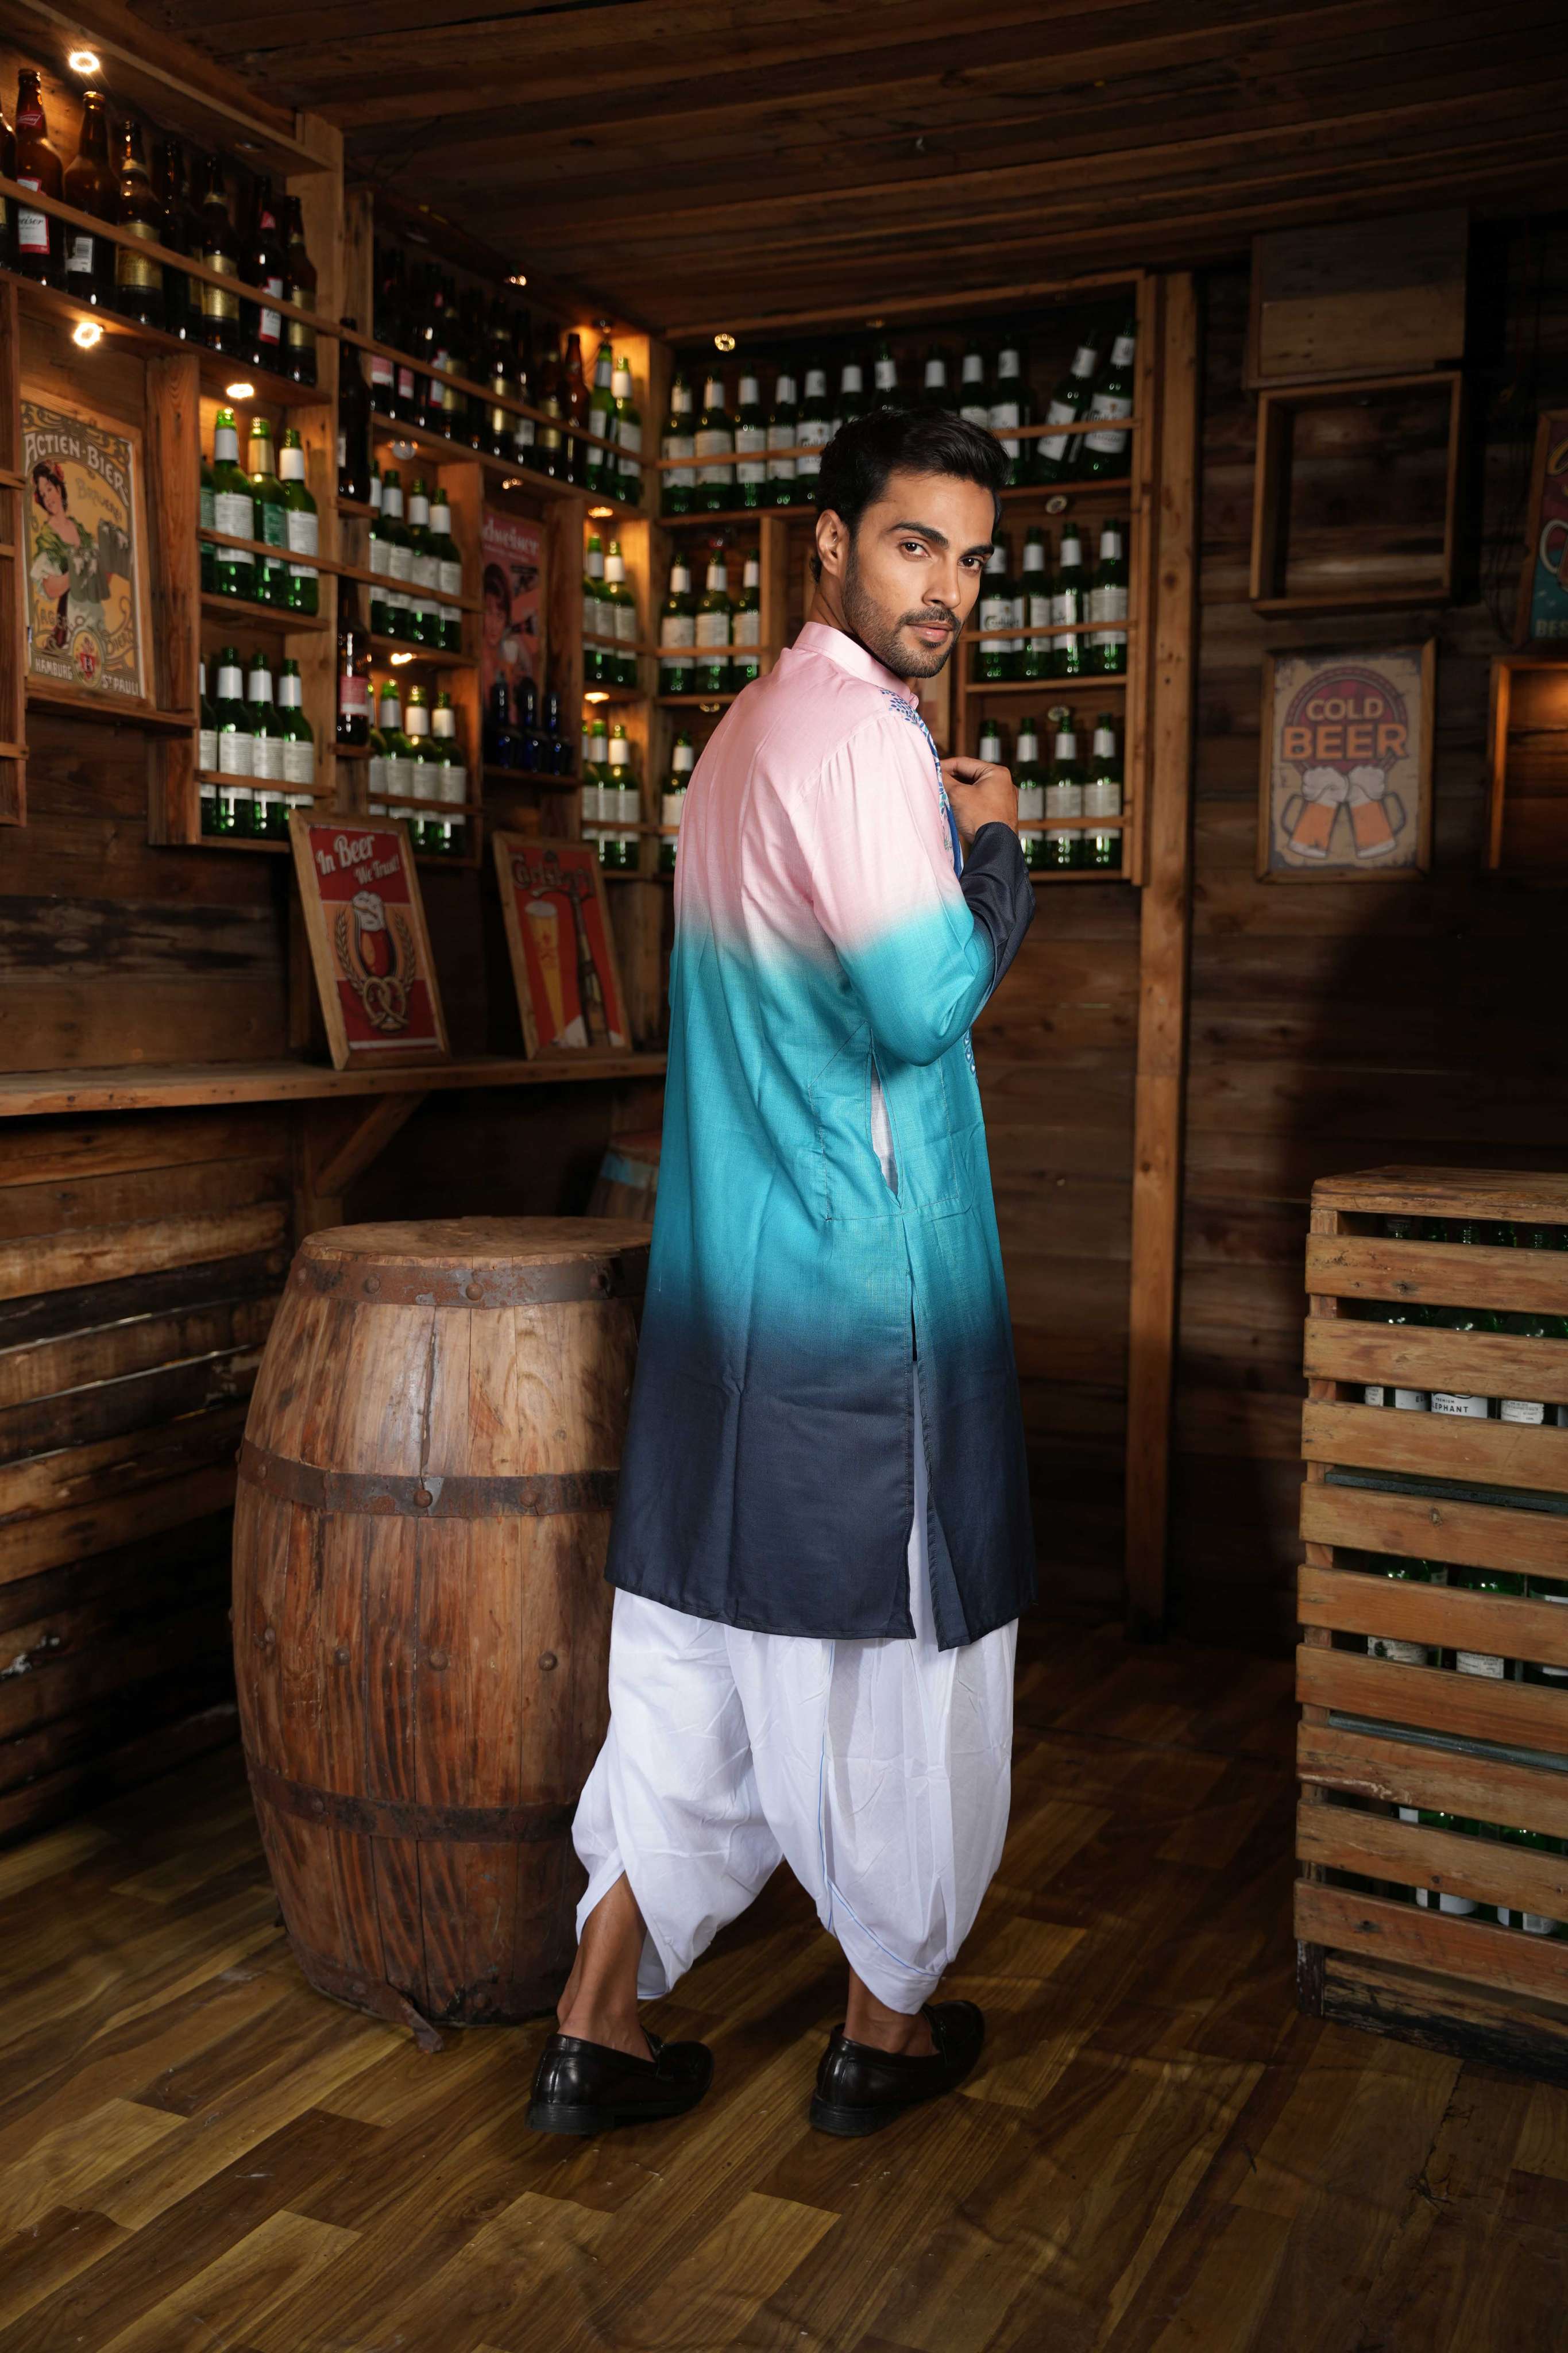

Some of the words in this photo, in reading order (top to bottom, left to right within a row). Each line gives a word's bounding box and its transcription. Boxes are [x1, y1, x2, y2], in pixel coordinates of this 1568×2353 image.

[35, 657, 74, 680] HAMBURG
[114, 676, 140, 697] PAULI
[1305, 696, 1384, 722] COLD
[1281, 723, 1408, 762] BEER
[315, 848, 336, 875] In
[333, 834, 375, 869] Beer
[354, 865, 373, 885] We
